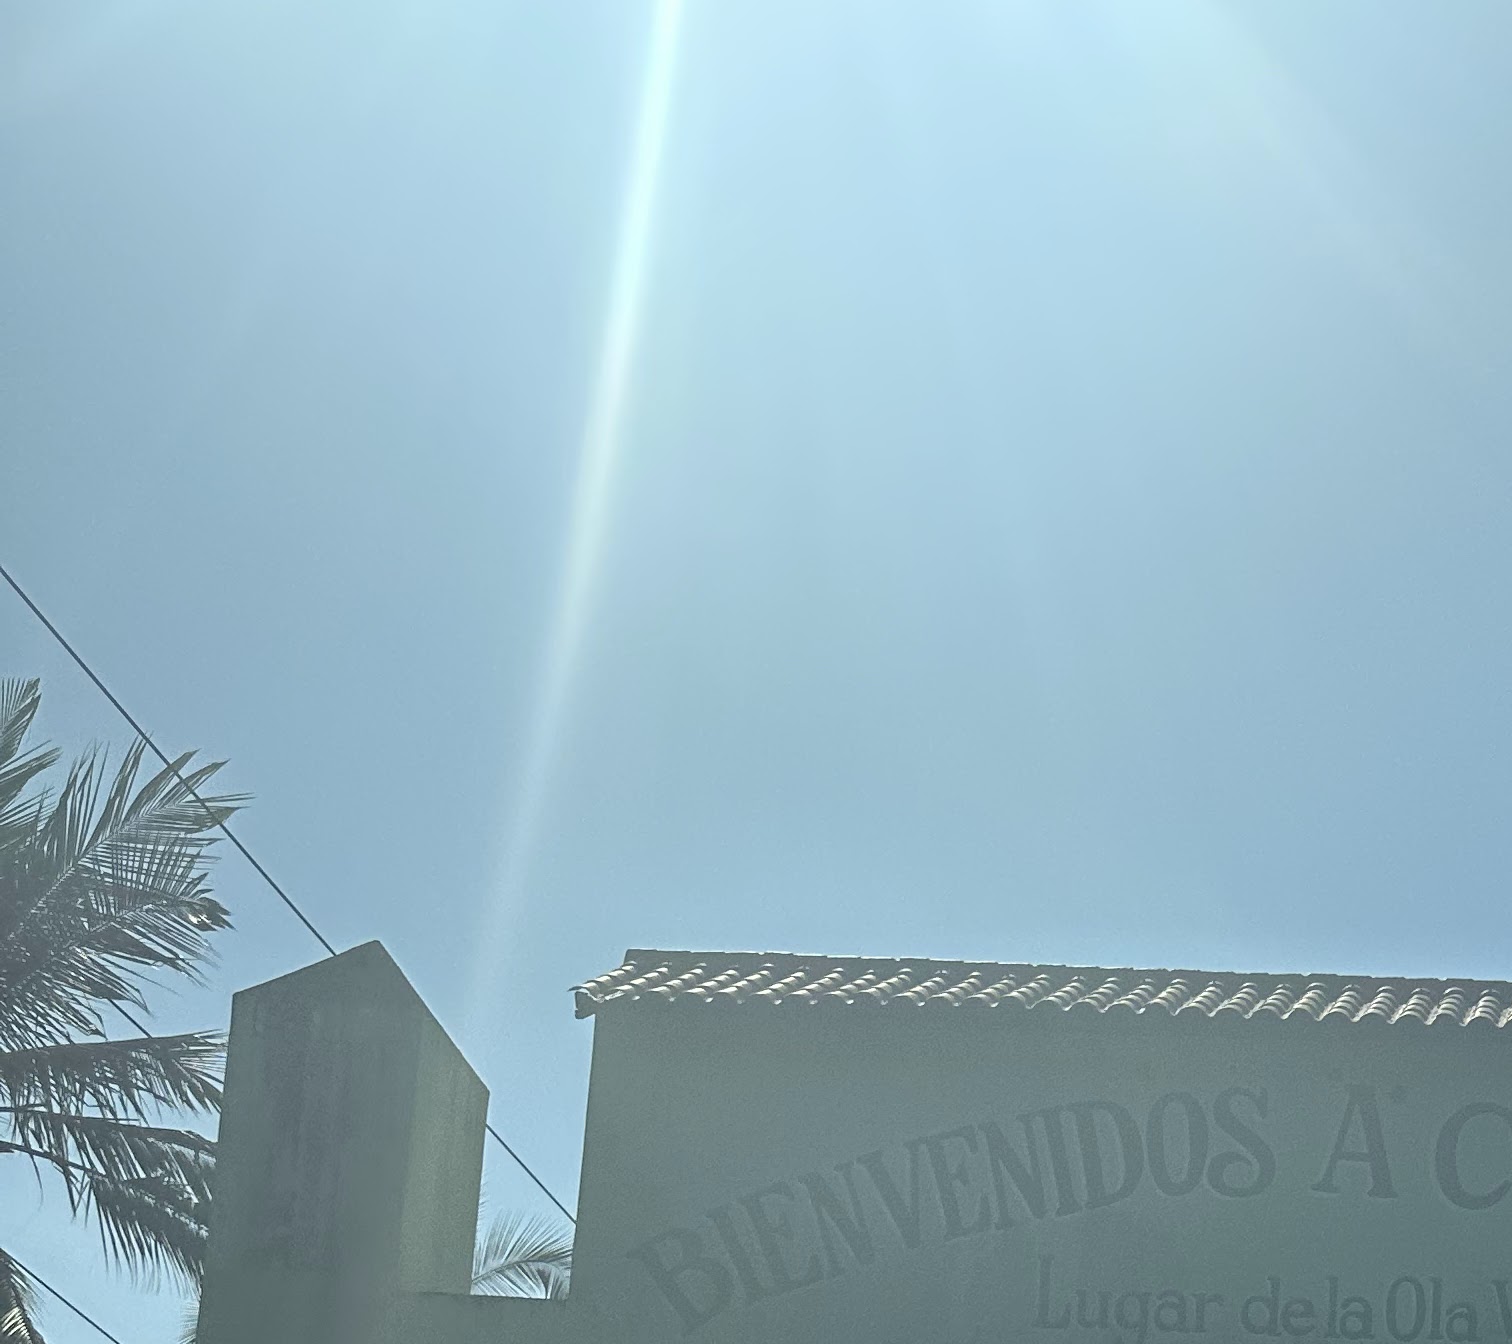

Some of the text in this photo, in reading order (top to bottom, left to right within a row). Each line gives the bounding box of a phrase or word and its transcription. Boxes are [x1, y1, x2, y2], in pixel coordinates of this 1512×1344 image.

[626, 1086, 1277, 1337] BIENVENIDOS
[1311, 1083, 1398, 1199] A
[1240, 1276, 1315, 1338] de
[1324, 1274, 1373, 1340] la
[1386, 1274, 1480, 1344] Ola
